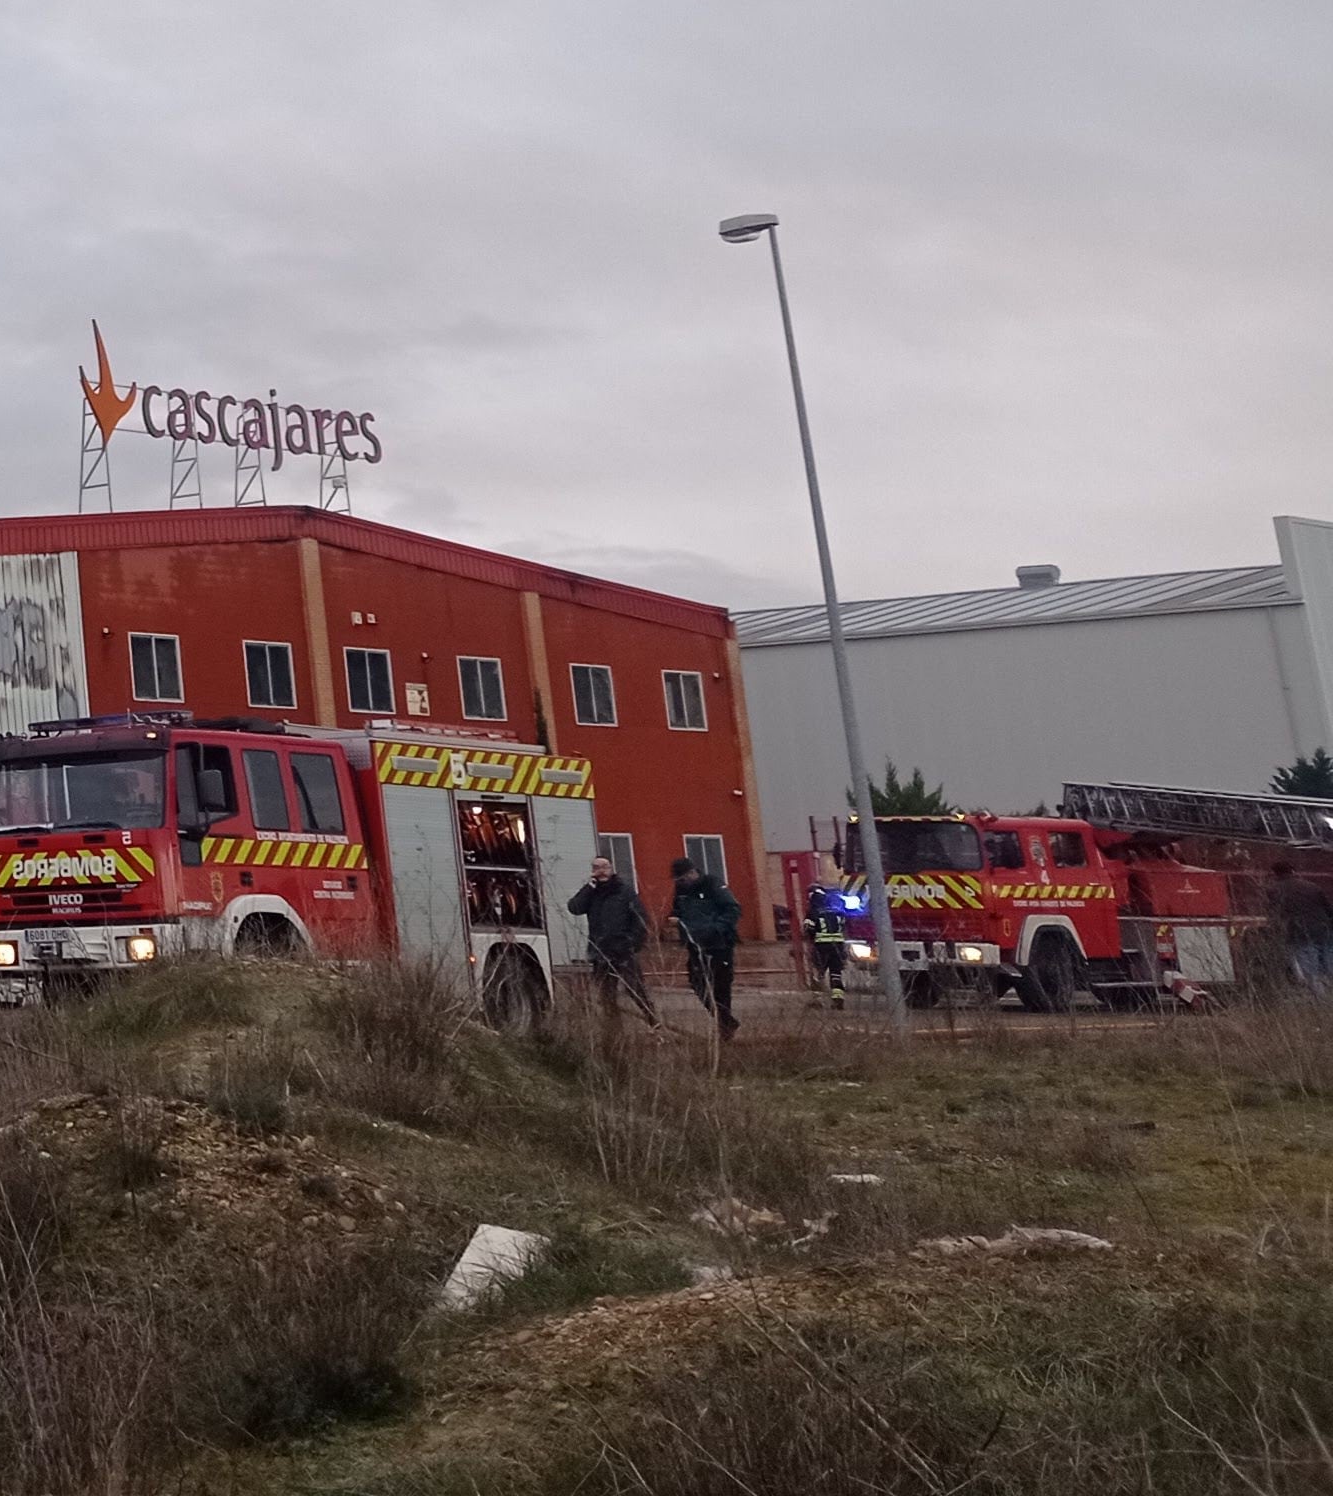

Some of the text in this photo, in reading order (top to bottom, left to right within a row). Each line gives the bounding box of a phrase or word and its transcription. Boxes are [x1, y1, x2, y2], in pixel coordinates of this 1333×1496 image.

[142, 385, 382, 471] cascajares
[450, 754, 466, 784] 5
[48, 893, 84, 906] IVECO
